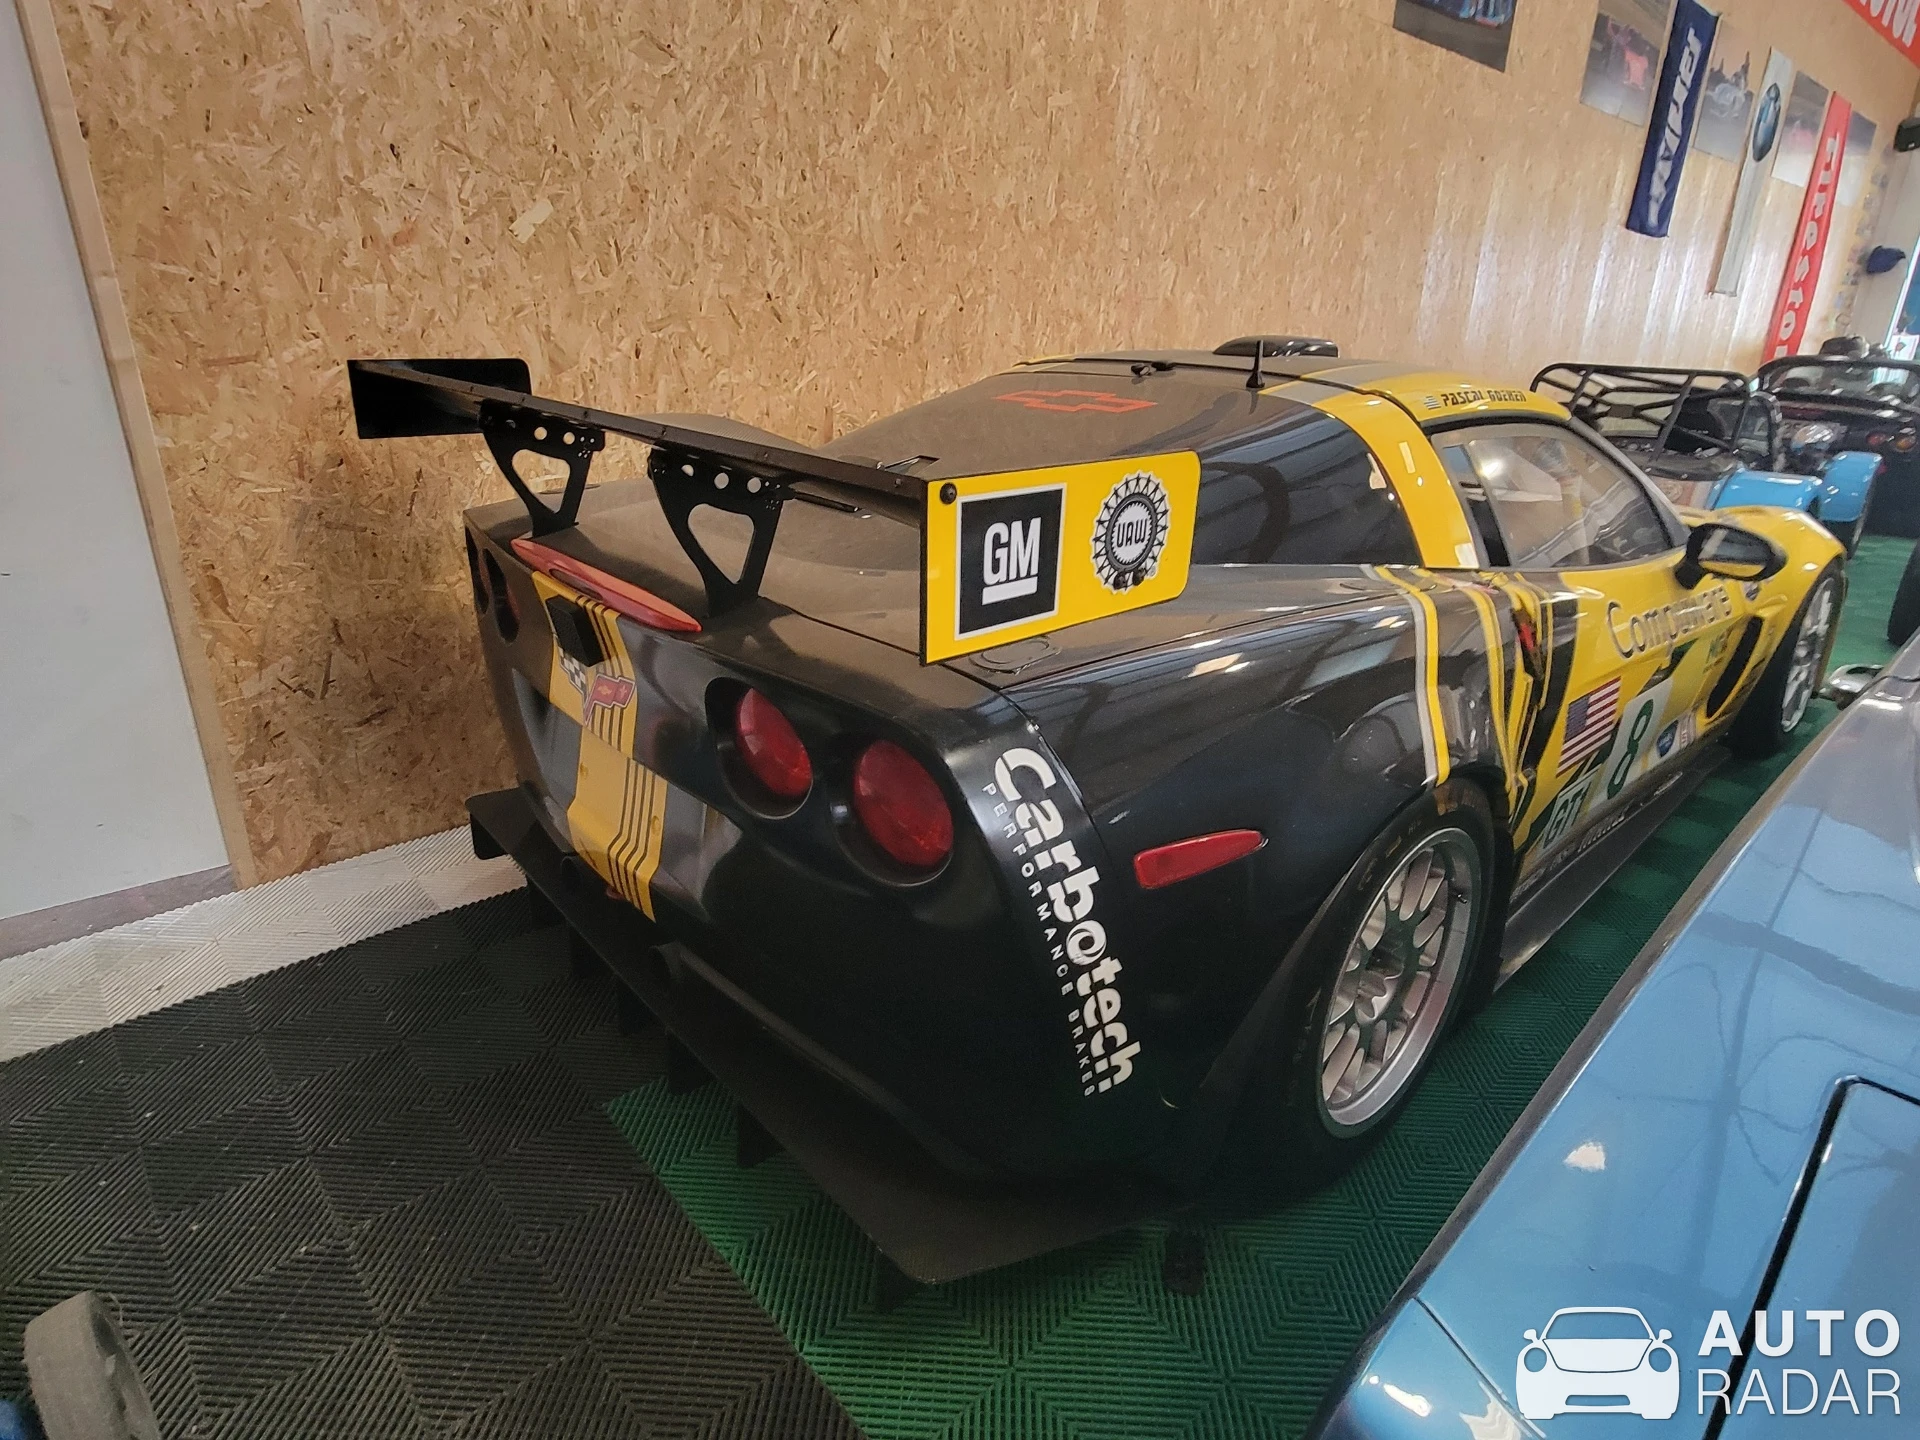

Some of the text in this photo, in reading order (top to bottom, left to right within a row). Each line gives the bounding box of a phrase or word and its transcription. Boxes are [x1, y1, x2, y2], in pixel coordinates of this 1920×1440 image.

[983, 516, 1042, 586] GM
[1116, 519, 1148, 548] UAW
[1606, 697, 1655, 801] 8
[981, 781, 1097, 1098] PERFORMANCE BRAKES
[994, 747, 1142, 1094] Carbotech
